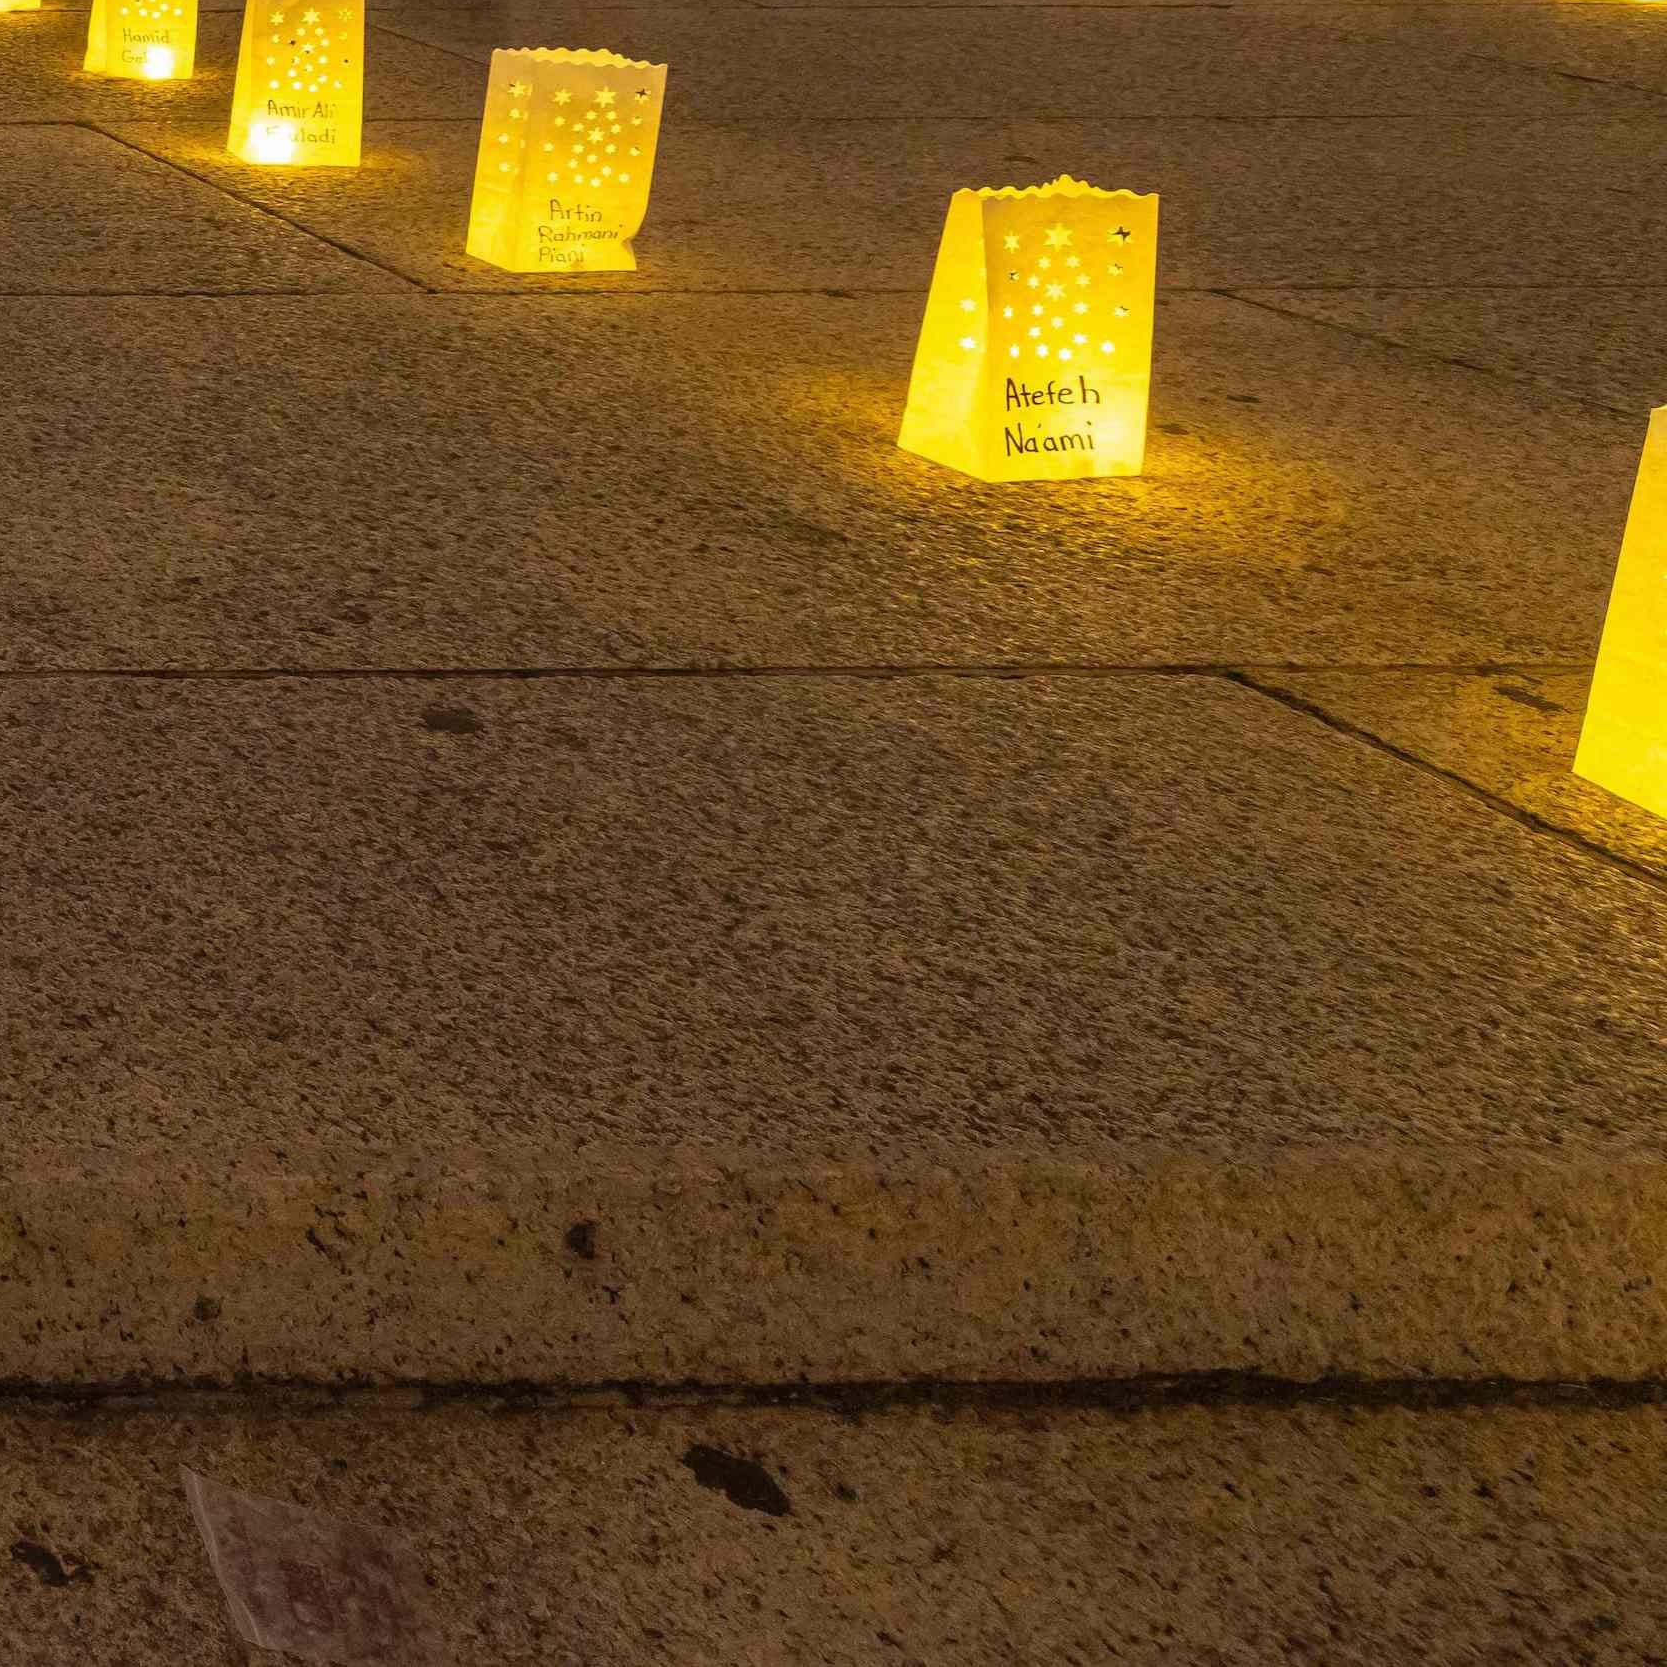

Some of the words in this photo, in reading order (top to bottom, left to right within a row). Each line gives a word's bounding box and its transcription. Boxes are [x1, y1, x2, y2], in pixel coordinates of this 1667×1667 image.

[122, 27, 171, 45] Hamid
[266, 99, 310, 119] Amir
[311, 101, 337, 119] Ali
[549, 198, 603, 223] Artin
[538, 223, 624, 244] Rahmani
[538, 243, 586, 264] Piani
[1005, 375, 1101, 412] Atefeh
